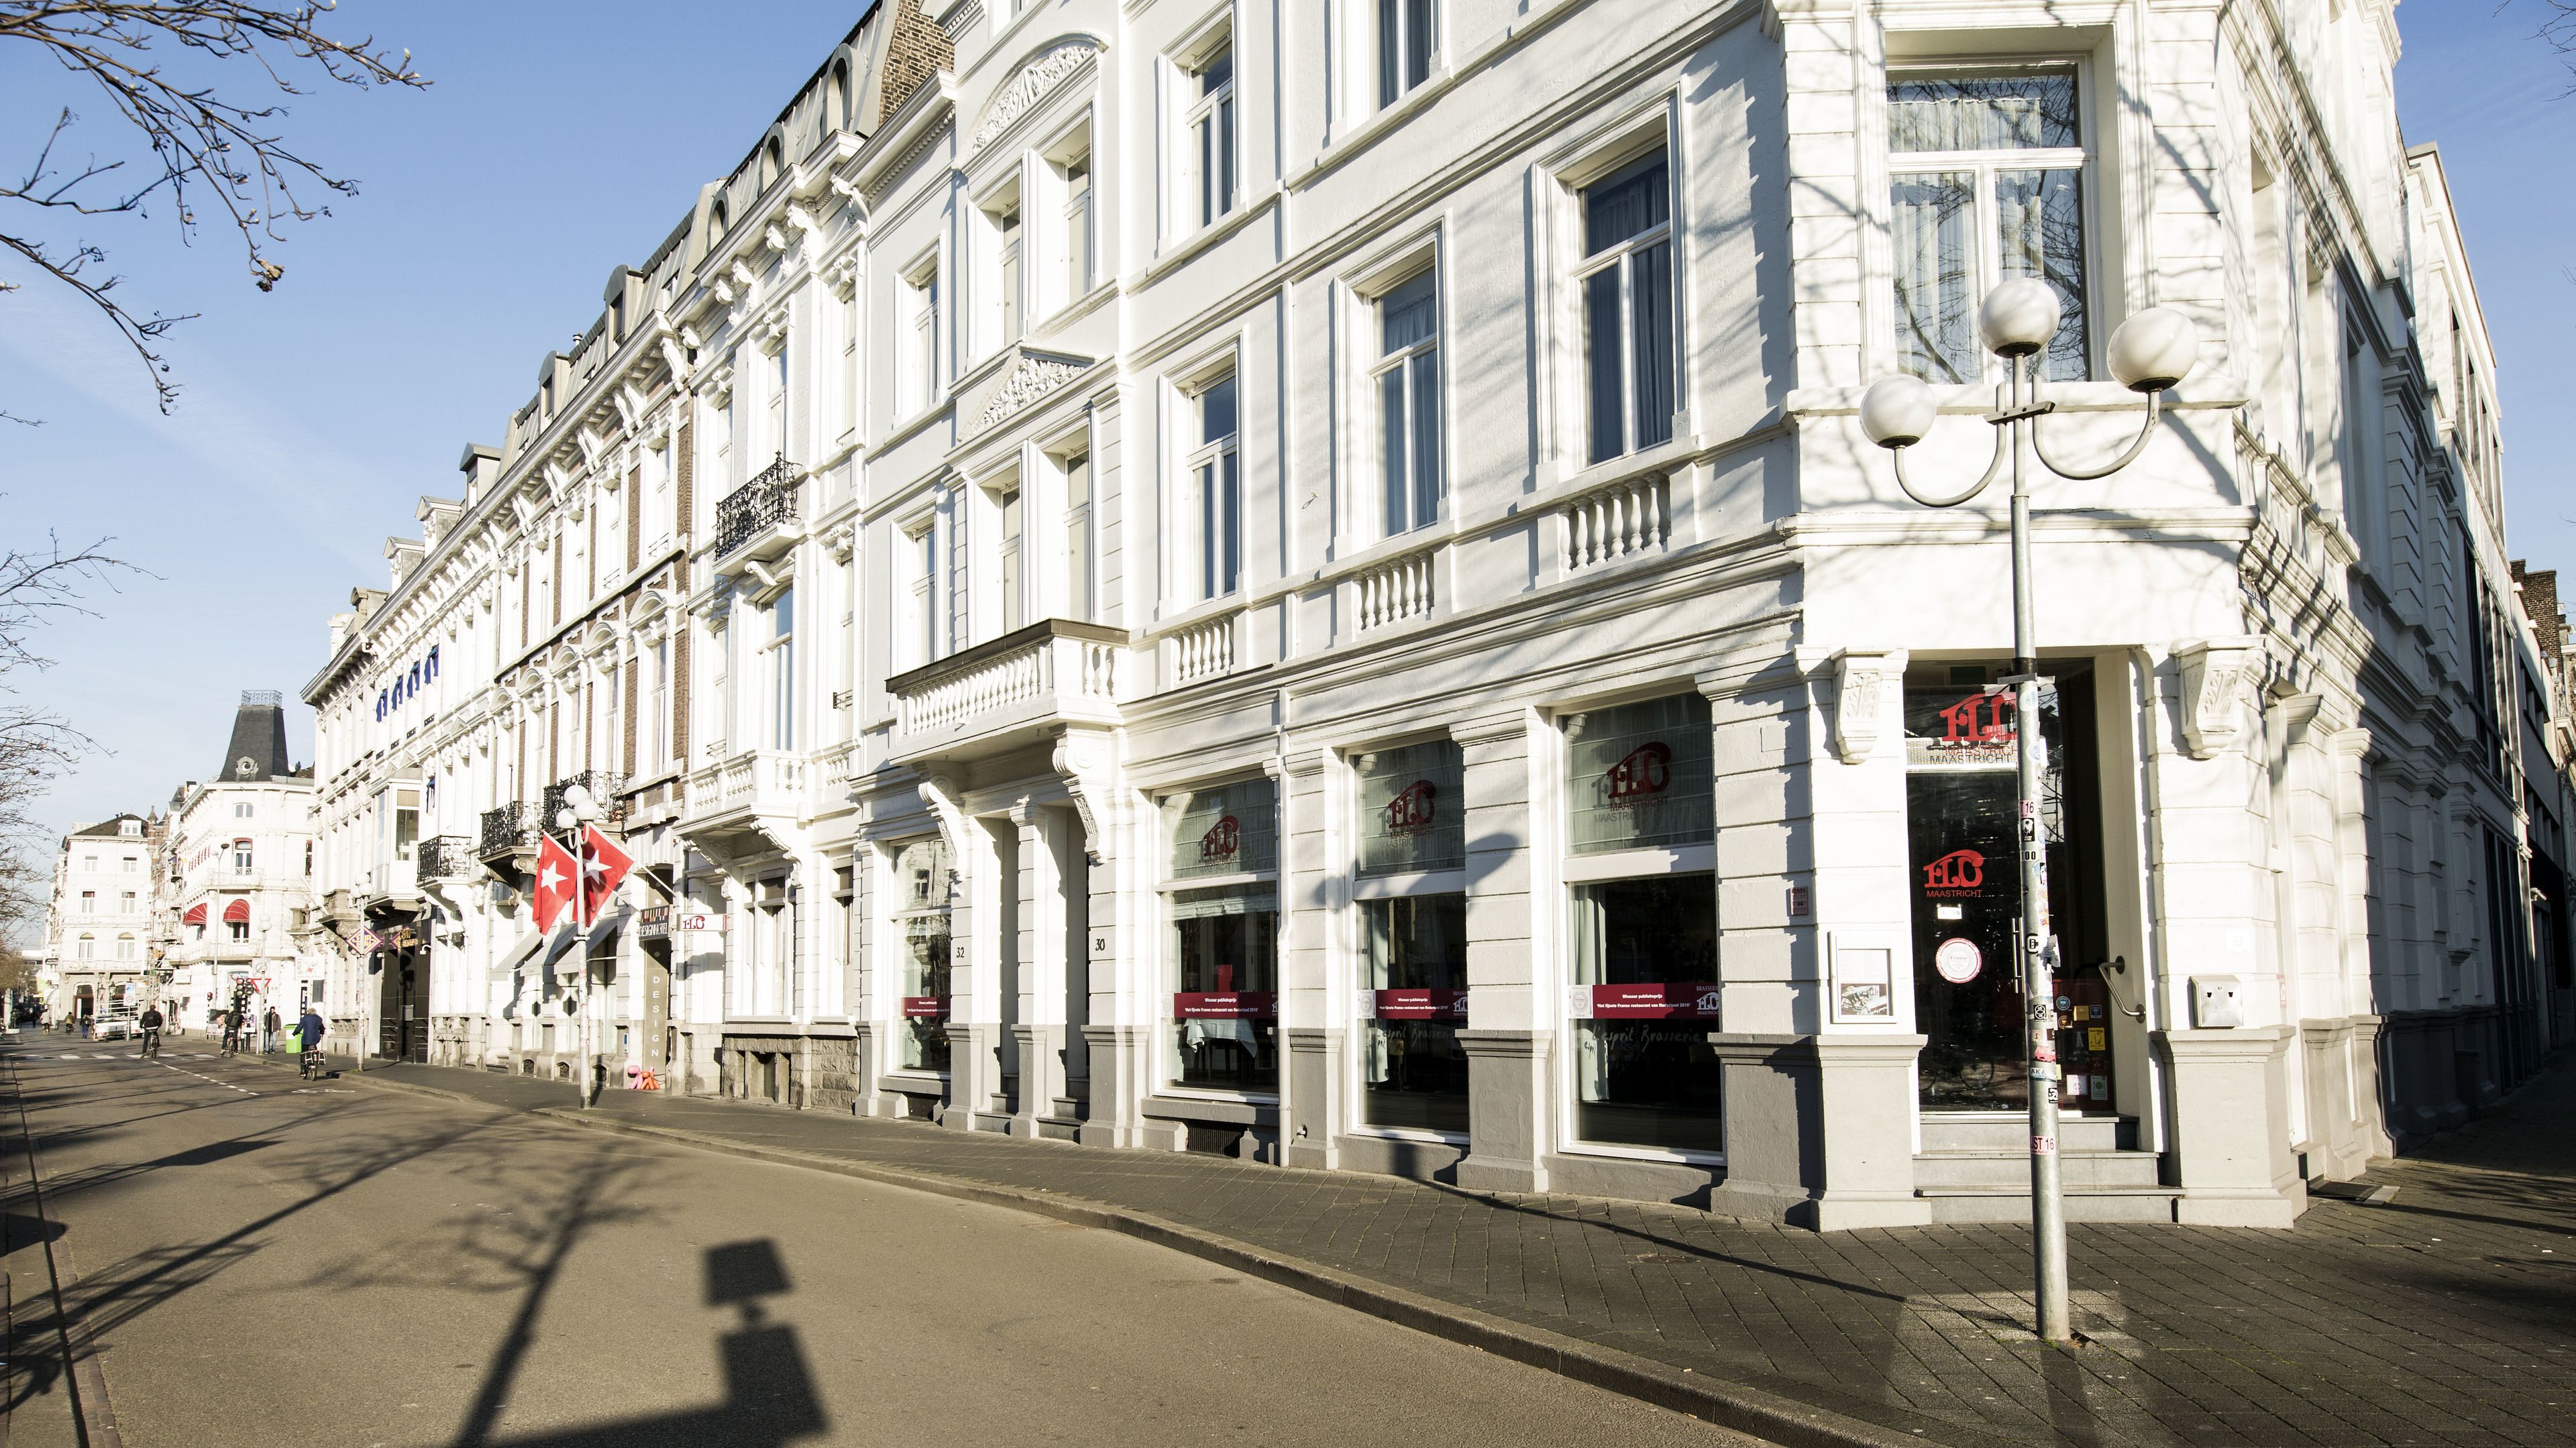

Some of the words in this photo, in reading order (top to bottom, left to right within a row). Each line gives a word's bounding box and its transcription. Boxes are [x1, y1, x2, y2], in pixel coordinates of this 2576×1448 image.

[1946, 745, 2017, 756] MAASTRICH
[1607, 742, 1670, 799] FLO
[1388, 780, 1436, 828] FLO
[1610, 796, 1669, 812] MAASTRICHT
[2026, 802, 2033, 813] 16
[1203, 816, 1238, 856] FLO
[1391, 827, 1433, 839] MAASTRICHT
[1923, 850, 1984, 887] FLO
[683, 915, 705, 929] FLO
[639, 923, 667, 937] DESIGNHOTEL
[1095, 939, 1105, 951] 30
[957, 947, 965, 958] 32
[1697, 993, 1719, 1010] FLO
[651, 977, 660, 1056] DESIGN
[2045, 1138, 2054, 1150] 16
